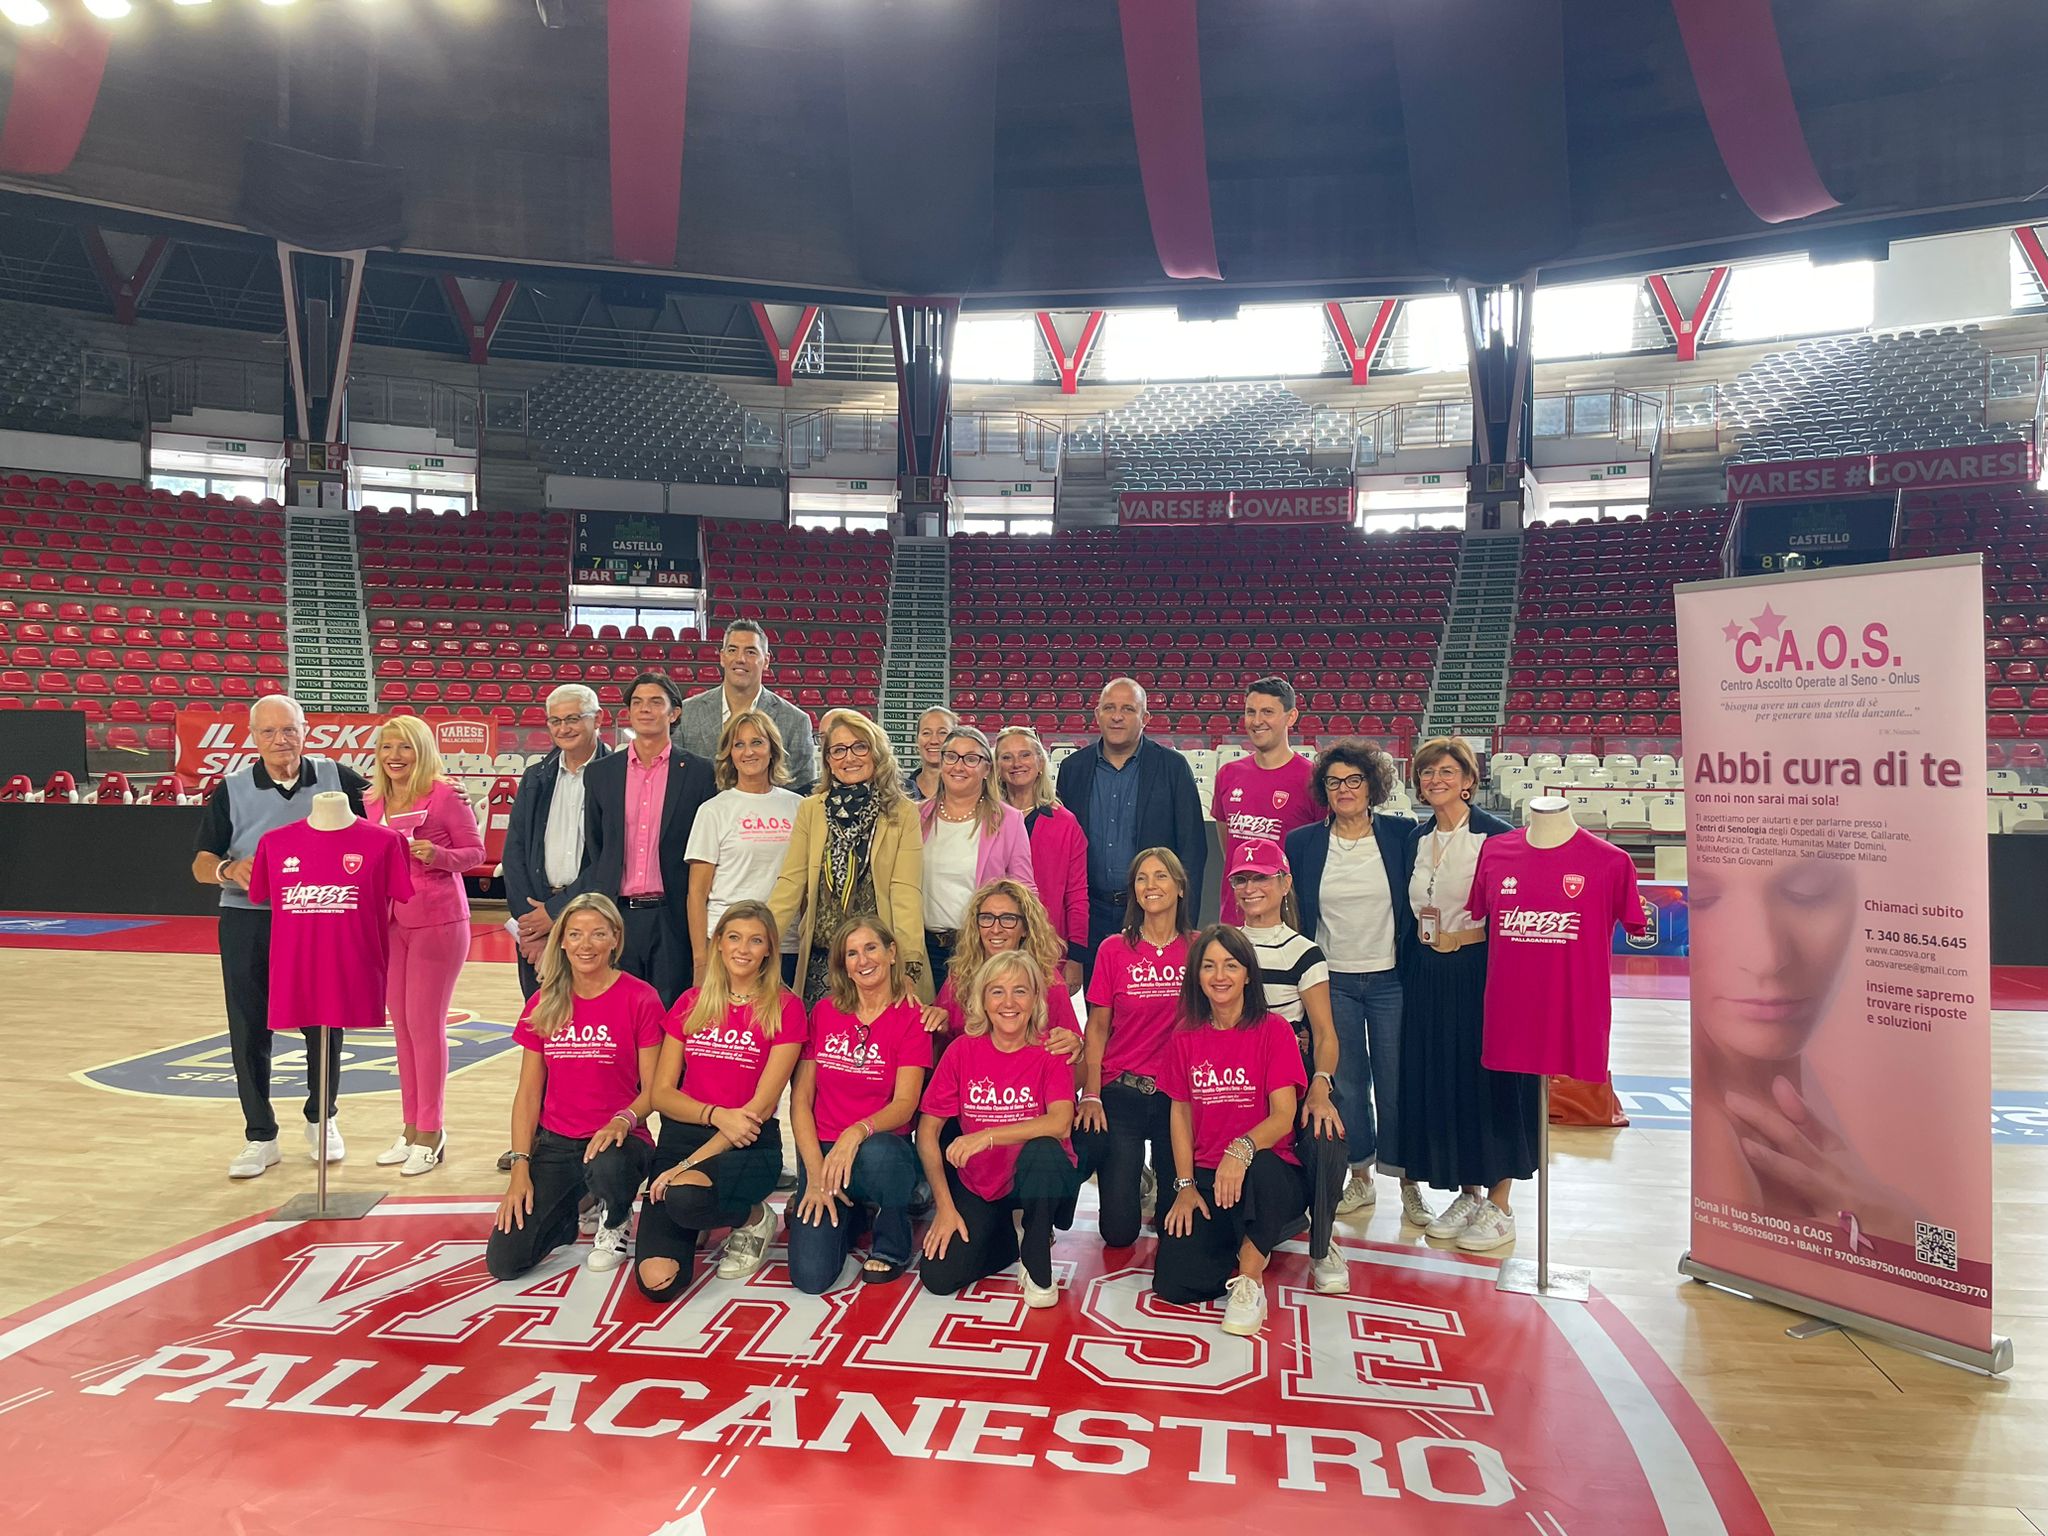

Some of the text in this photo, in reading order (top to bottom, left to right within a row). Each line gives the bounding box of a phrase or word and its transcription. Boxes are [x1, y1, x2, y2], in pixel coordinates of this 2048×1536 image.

[1729, 453, 2034, 495] VARESE #GOVARESE
[1120, 497, 1349, 520] VARESE #GOVARESE
[613, 541, 663, 551] CASTELLO
[1789, 533, 1850, 545] CASTELLO
[592, 557, 601, 569] 7
[1762, 556, 1773, 569] 8
[580, 570, 611, 581] BAR
[658, 573, 689, 584] BAR
[1735, 622, 1901, 674] C.A.O.S.
[1720, 679, 1753, 691] Centro
[1755, 678, 1793, 690] Ascolto
[1795, 676, 1836, 691] Operate
[1839, 674, 1848, 686] al
[1851, 674, 1878, 686] Seno
[1888, 672, 1920, 684] Onlus
[1801, 701, 1821, 709] caos
[1824, 698, 1854, 708] dentro
[1856, 698, 1866, 707] di
[1755, 712, 1770, 722] per
[1772, 711, 1811, 721] generare
[1814, 711, 1832, 719] una
[1835, 709, 1860, 718] stella
[197, 723, 235, 748] IL
[440, 726, 484, 738] VARESE
[1694, 751, 1961, 787] Abbi cura di te
[1695, 793, 1839, 806] con noi non sarai mai sola!
[1230, 810, 1280, 834] VARESE
[1696, 813, 1701, 821] Ti
[1703, 814, 1744, 824] aspettiamo
[1747, 816, 1759, 824] per
[1762, 815, 1791, 824] aiutarti
[1801, 818, 1814, 827] per
[1816, 818, 1852, 829] parlarne
[1854, 821, 1882, 830] presso
[1696, 824, 1716, 832] Centri
[1718, 824, 1725, 832] di
[1727, 824, 1767, 835] Senologia
[1769, 826, 1787, 837] degli
[1790, 827, 1825, 838] Ospedali
[1828, 828, 1835, 837] di
[1871, 830, 1911, 841] Gallarate,
[1696, 834, 1715, 842] Busto
[1782, 838, 1824, 848] Humanitas
[1827, 840, 1851, 849] Mater
[1854, 841, 1887, 851] Domini,
[1696, 844, 1740, 854] MultiMedica
[1742, 845, 1749, 854] di
[1800, 849, 1815, 858] San
[1817, 850, 1856, 862] Giuseppe
[1858, 852, 1887, 862] Milano
[1702, 855, 1720, 864] Sesto
[1722, 856, 1736, 865] San
[1738, 857, 1773, 867] Giovanni
[286, 881, 355, 907] VARESE
[1864, 900, 1964, 918] Chiamaci subito
[1503, 905, 1577, 935] VARESE
[1511, 937, 1567, 945] PALLACANESTRO
[1865, 929, 1967, 949] T. 340 86.54.645
[1865, 945, 1936, 961] www.caosva.org
[1865, 958, 1968, 977] caosvarese@gmail.com
[1866, 980, 1974, 1004] insieme sapremo
[1867, 997, 1967, 1020] trovare risposte
[1867, 1014, 1931, 1032] e soluzioni
[1193, 1068, 1250, 1087] C.A.O.S.
[970, 1086, 1034, 1104] C.A.O.S.
[1694, 1197, 1833, 1243] Dona il tuo 5x1000 a CAOS
[1694, 1212, 1711, 1224] Cod.
[1713, 1217, 1731, 1230] Fisc.
[1732, 1222, 1789, 1245] 95051260123
[1797, 1240, 1822, 1255] IBAN:
[1824, 1247, 1833, 1257] IT
[215, 1240, 1494, 1415] VARESE
[81, 1345, 1516, 1506] PALLACANESTRO
